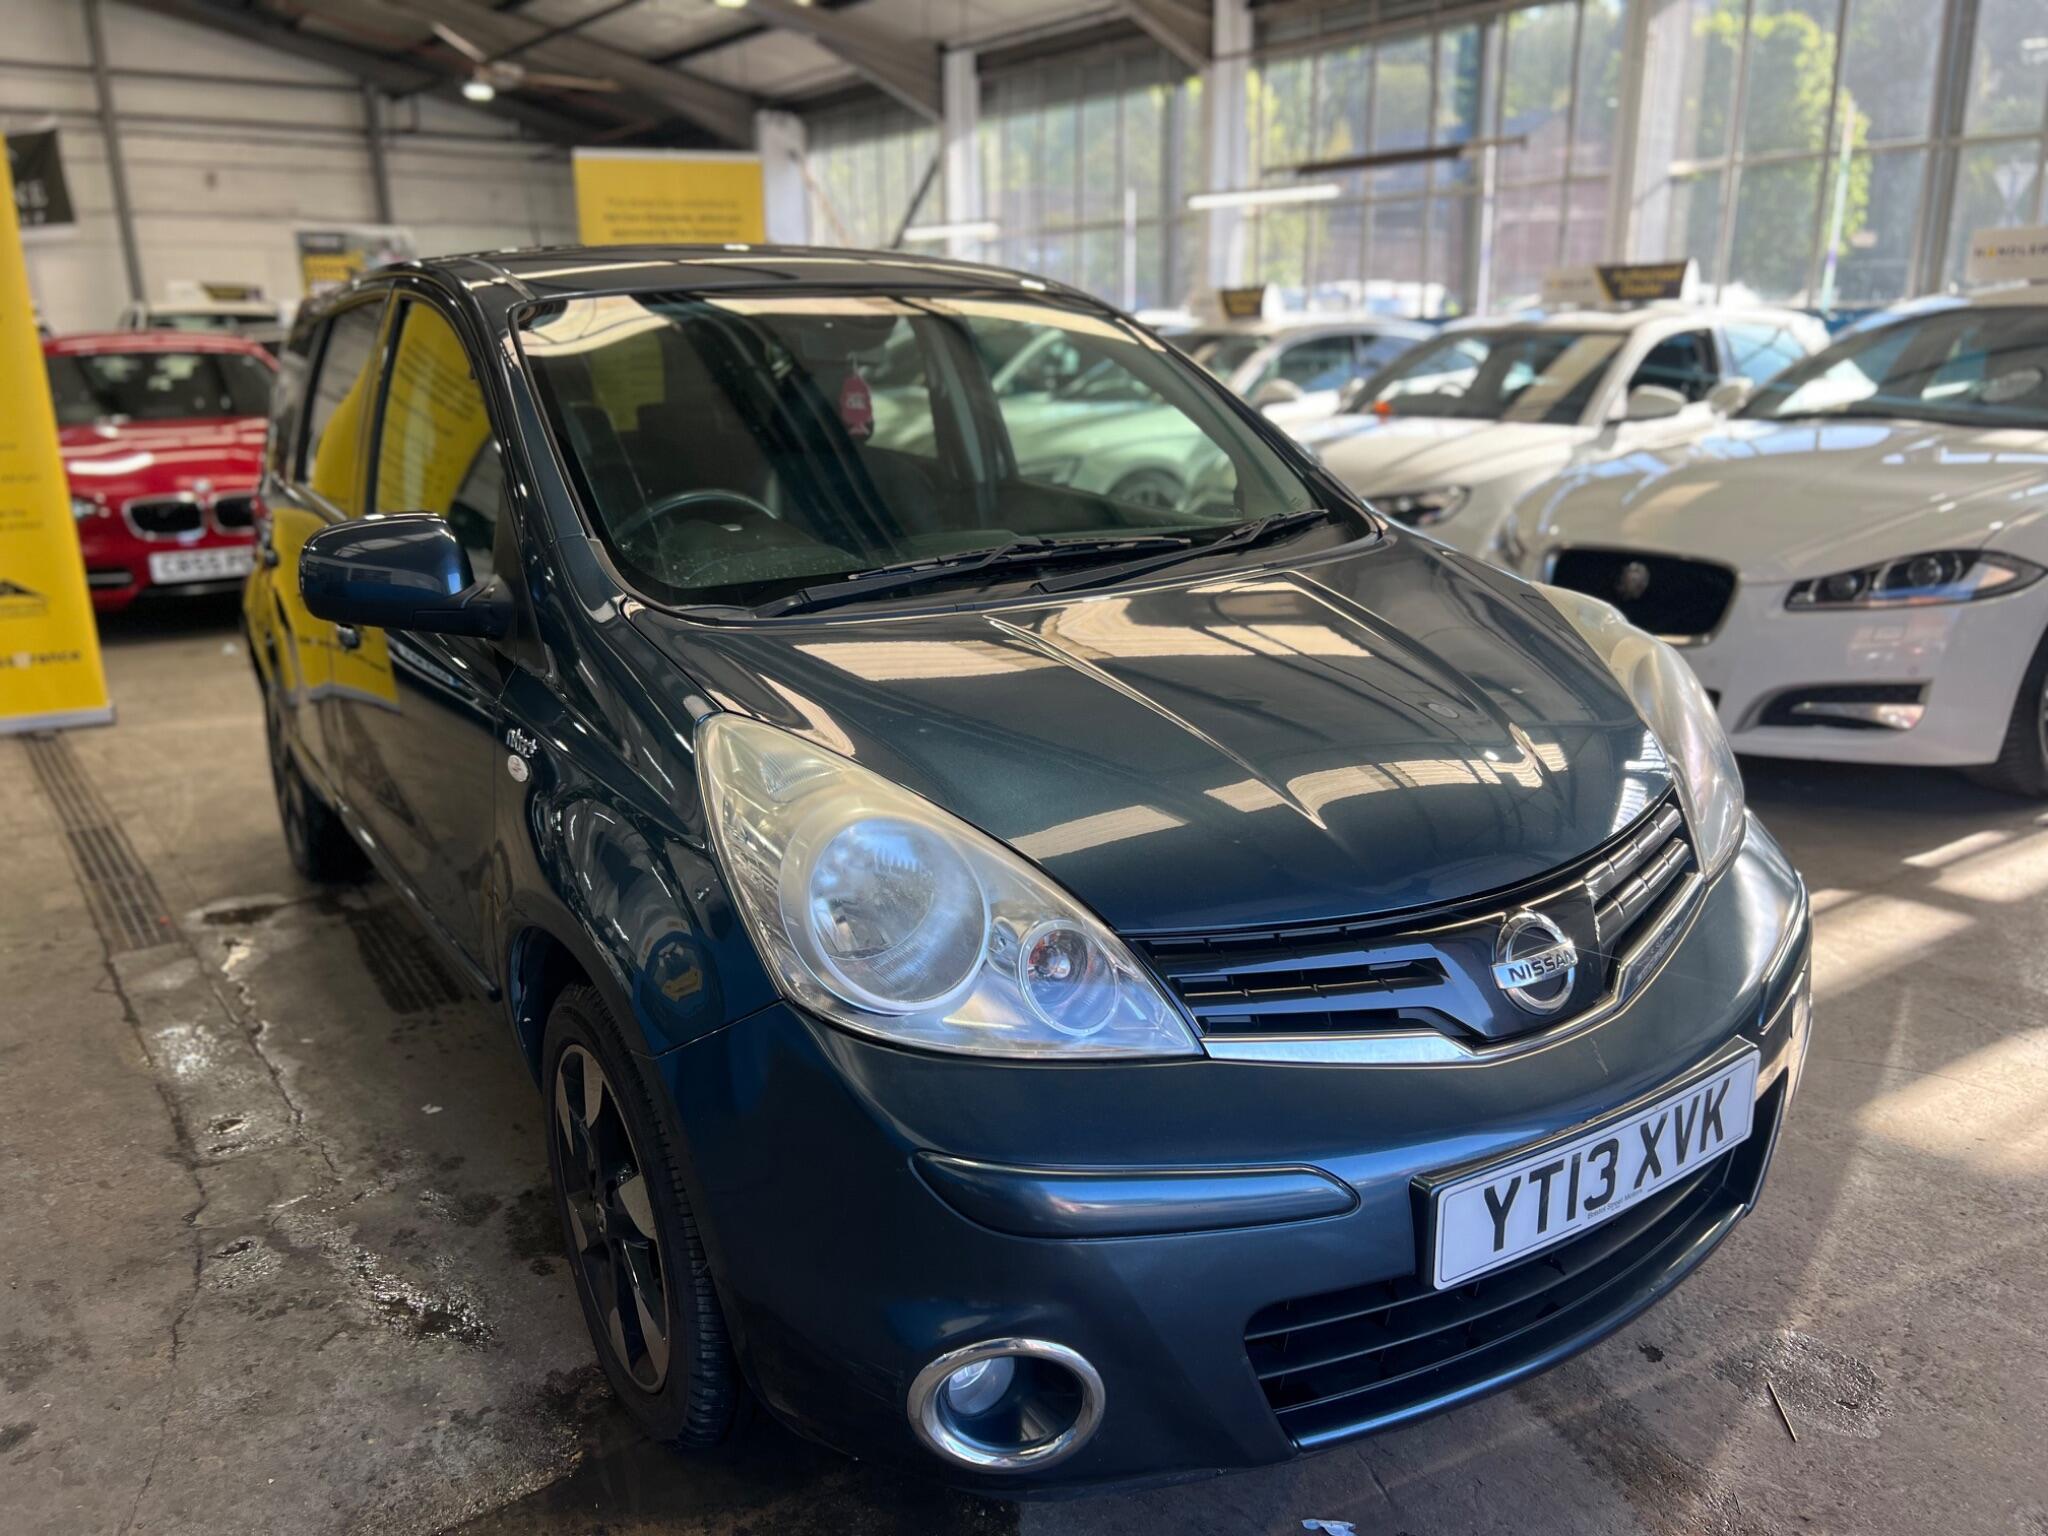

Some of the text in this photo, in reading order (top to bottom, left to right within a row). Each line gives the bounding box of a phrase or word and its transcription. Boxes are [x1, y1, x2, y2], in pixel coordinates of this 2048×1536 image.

[1507, 949, 1574, 982] NISSAN
[1484, 1077, 1731, 1252] YT13 XVK
